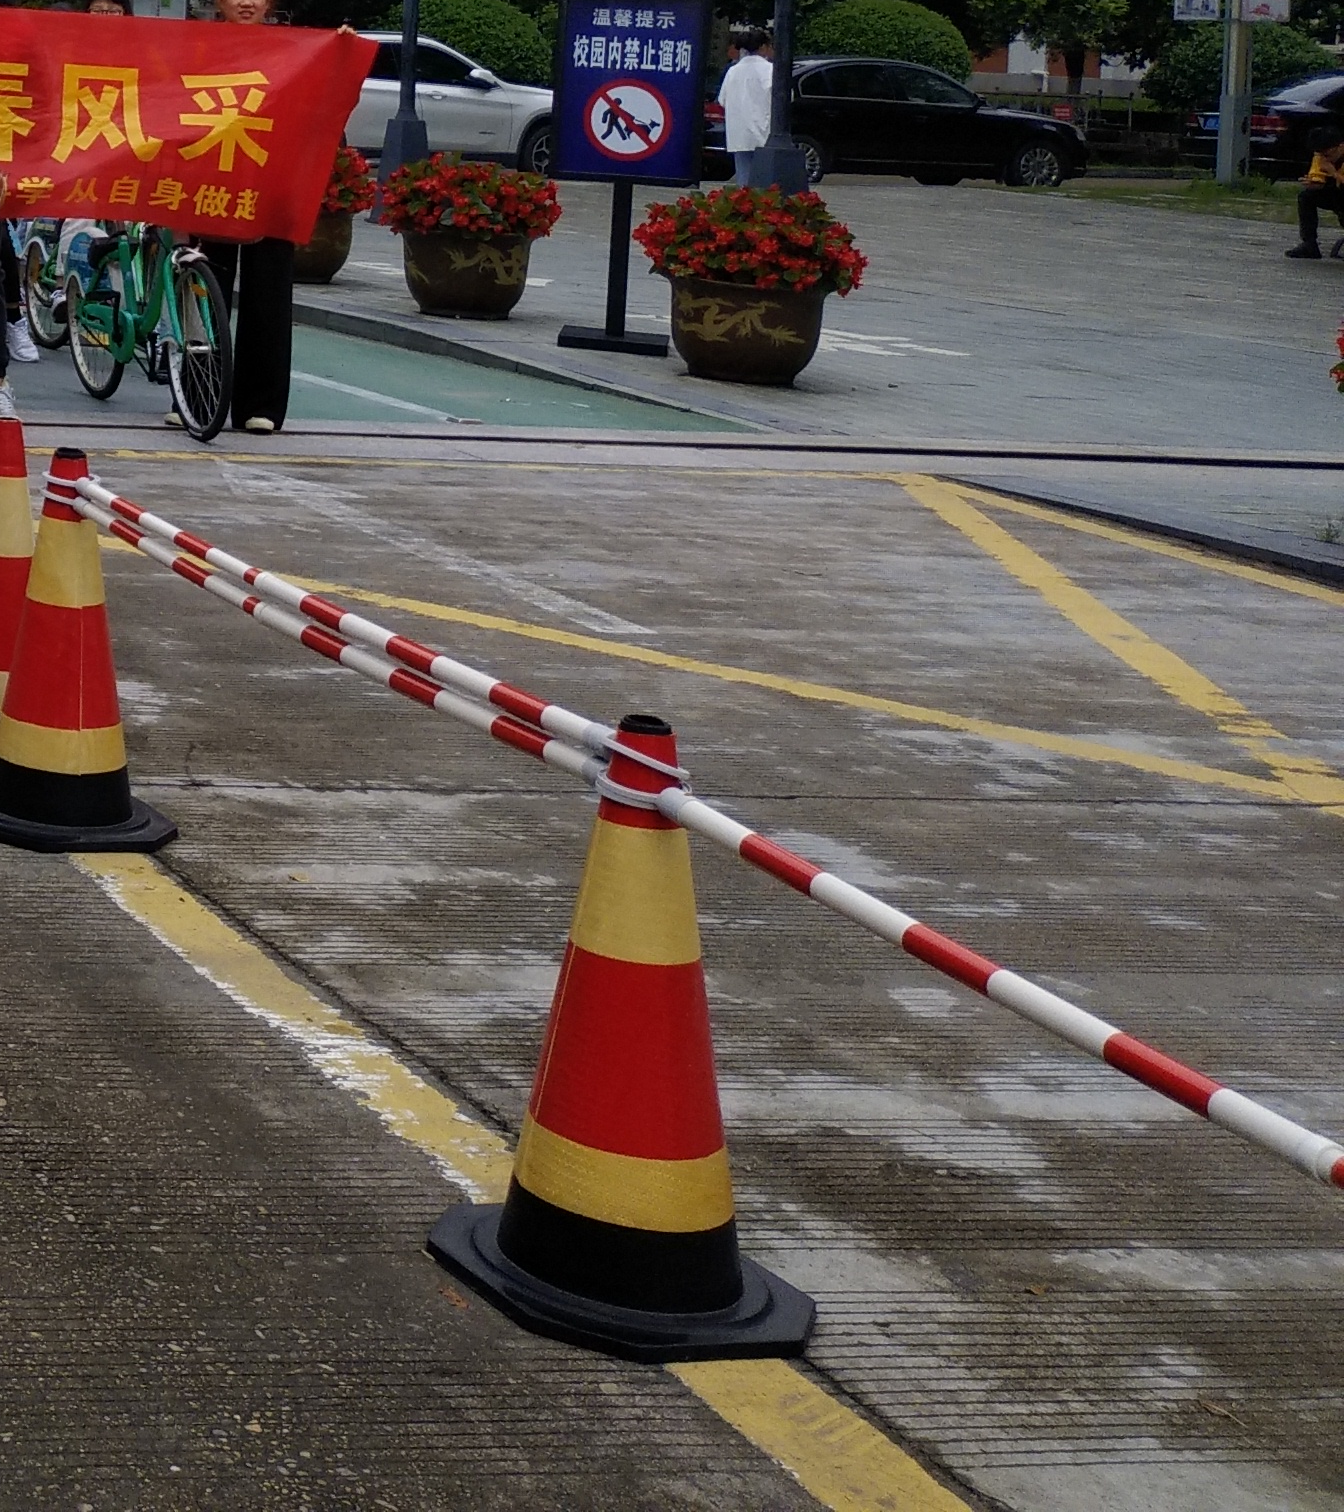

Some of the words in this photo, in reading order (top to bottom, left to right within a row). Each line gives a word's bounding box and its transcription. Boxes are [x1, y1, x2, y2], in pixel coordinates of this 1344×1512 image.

[592, 7, 676, 29] 温馨提示
[573, 34, 692, 74] 校园内禁止遛狗
